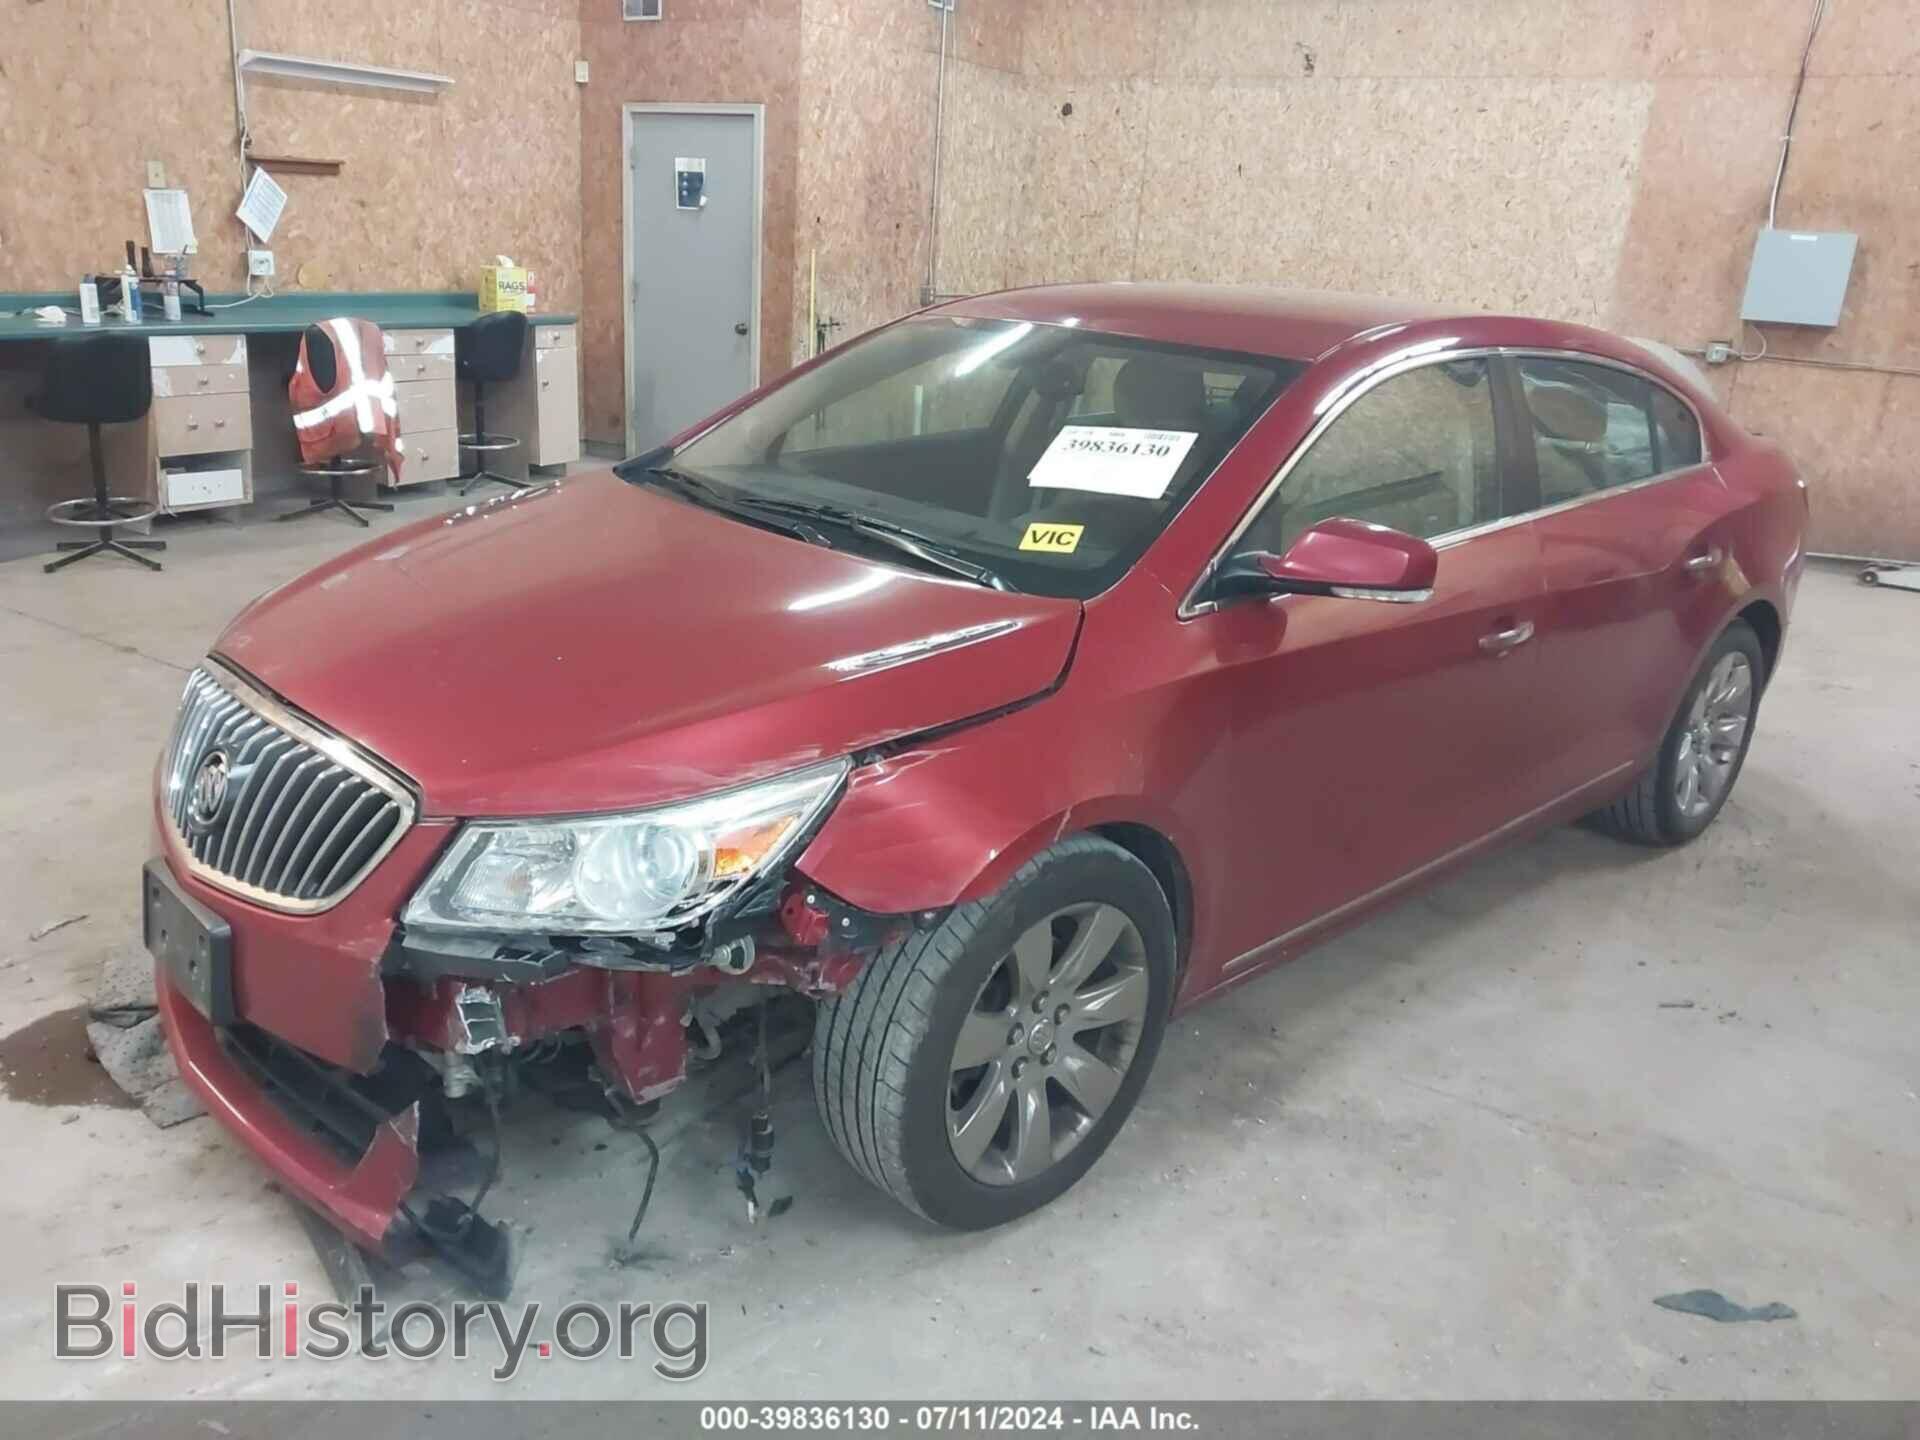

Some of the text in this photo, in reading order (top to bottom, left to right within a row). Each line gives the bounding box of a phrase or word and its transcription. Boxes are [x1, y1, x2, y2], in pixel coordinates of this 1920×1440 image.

[498, 281, 525, 291] RAGS
[1063, 438, 1171, 457] 39836130
[1030, 529, 1075, 546] VIC
